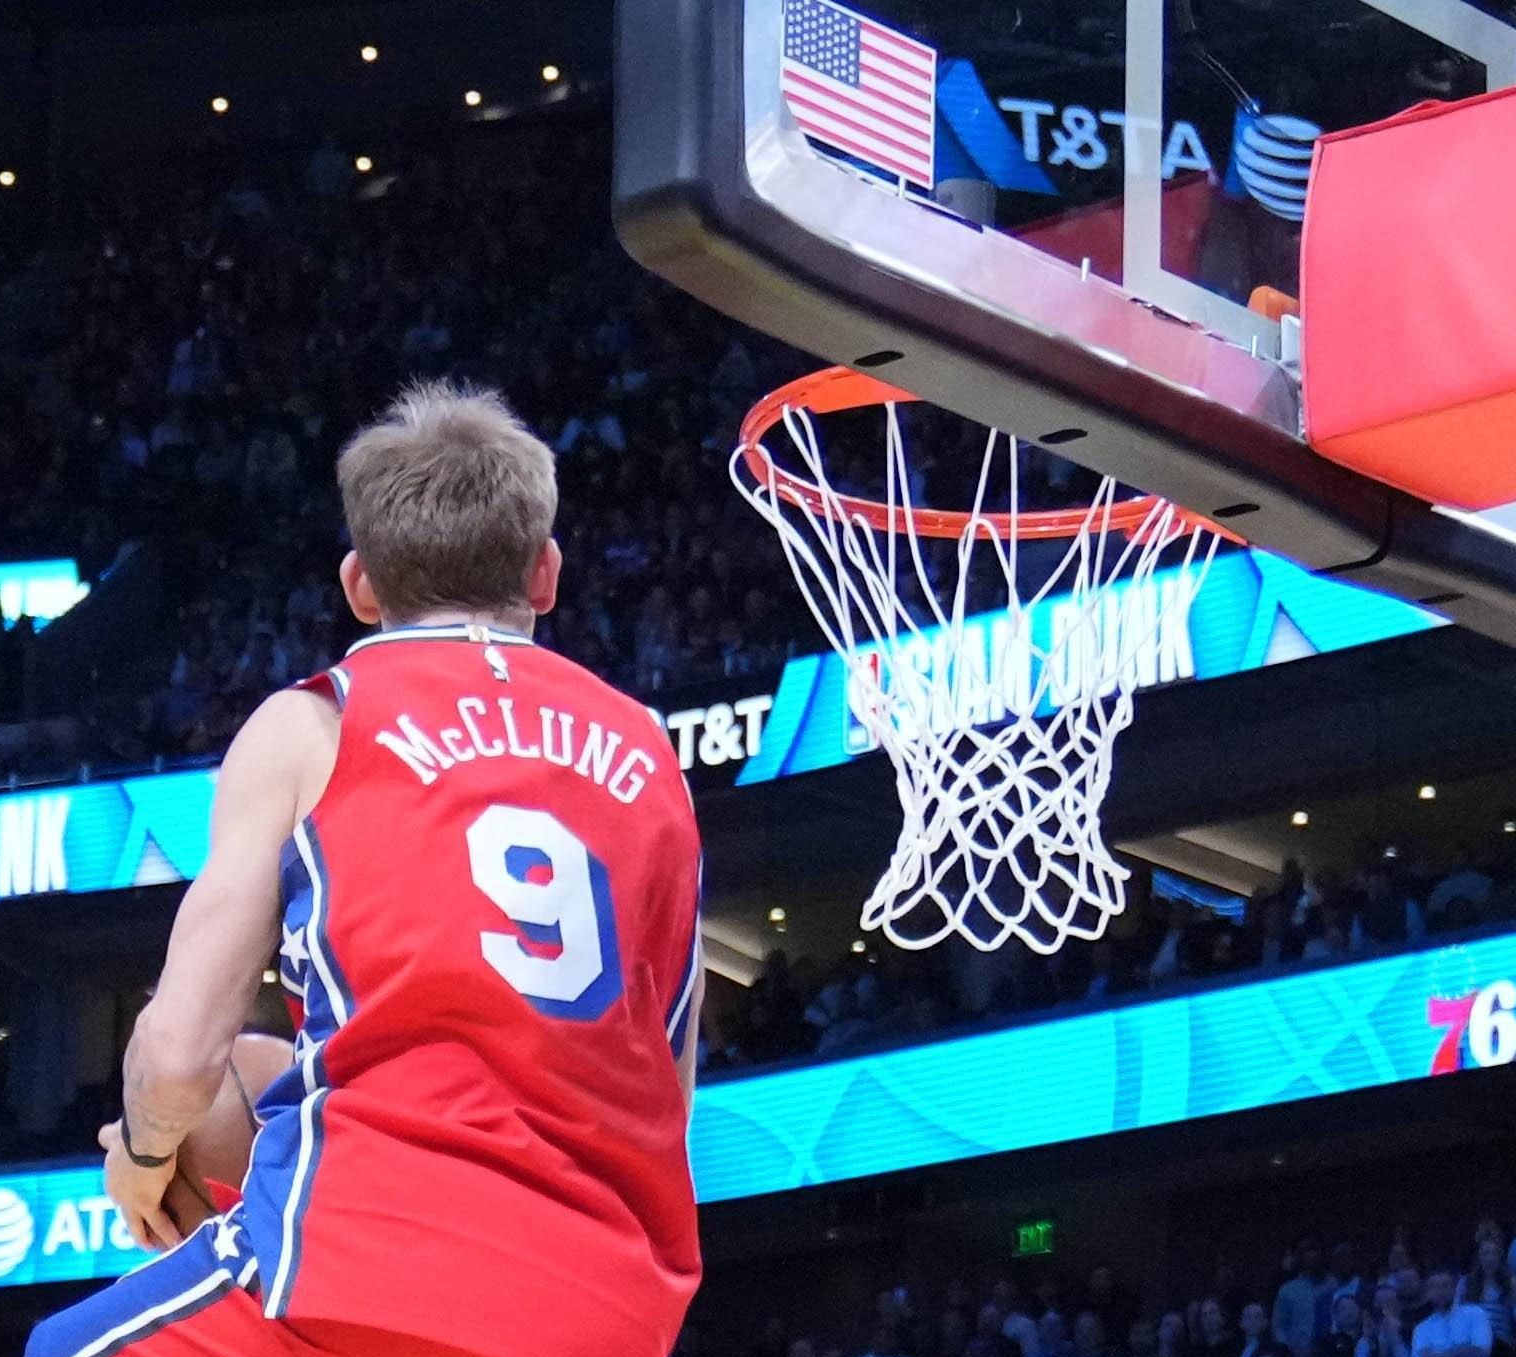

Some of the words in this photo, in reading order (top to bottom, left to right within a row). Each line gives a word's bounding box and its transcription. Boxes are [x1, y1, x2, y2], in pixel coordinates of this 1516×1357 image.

[1050, 570, 1198, 704] DUNK
[375, 695, 657, 804] McCLUNG
[647, 695, 773, 772] T&T
[466, 803, 622, 1020] 9
